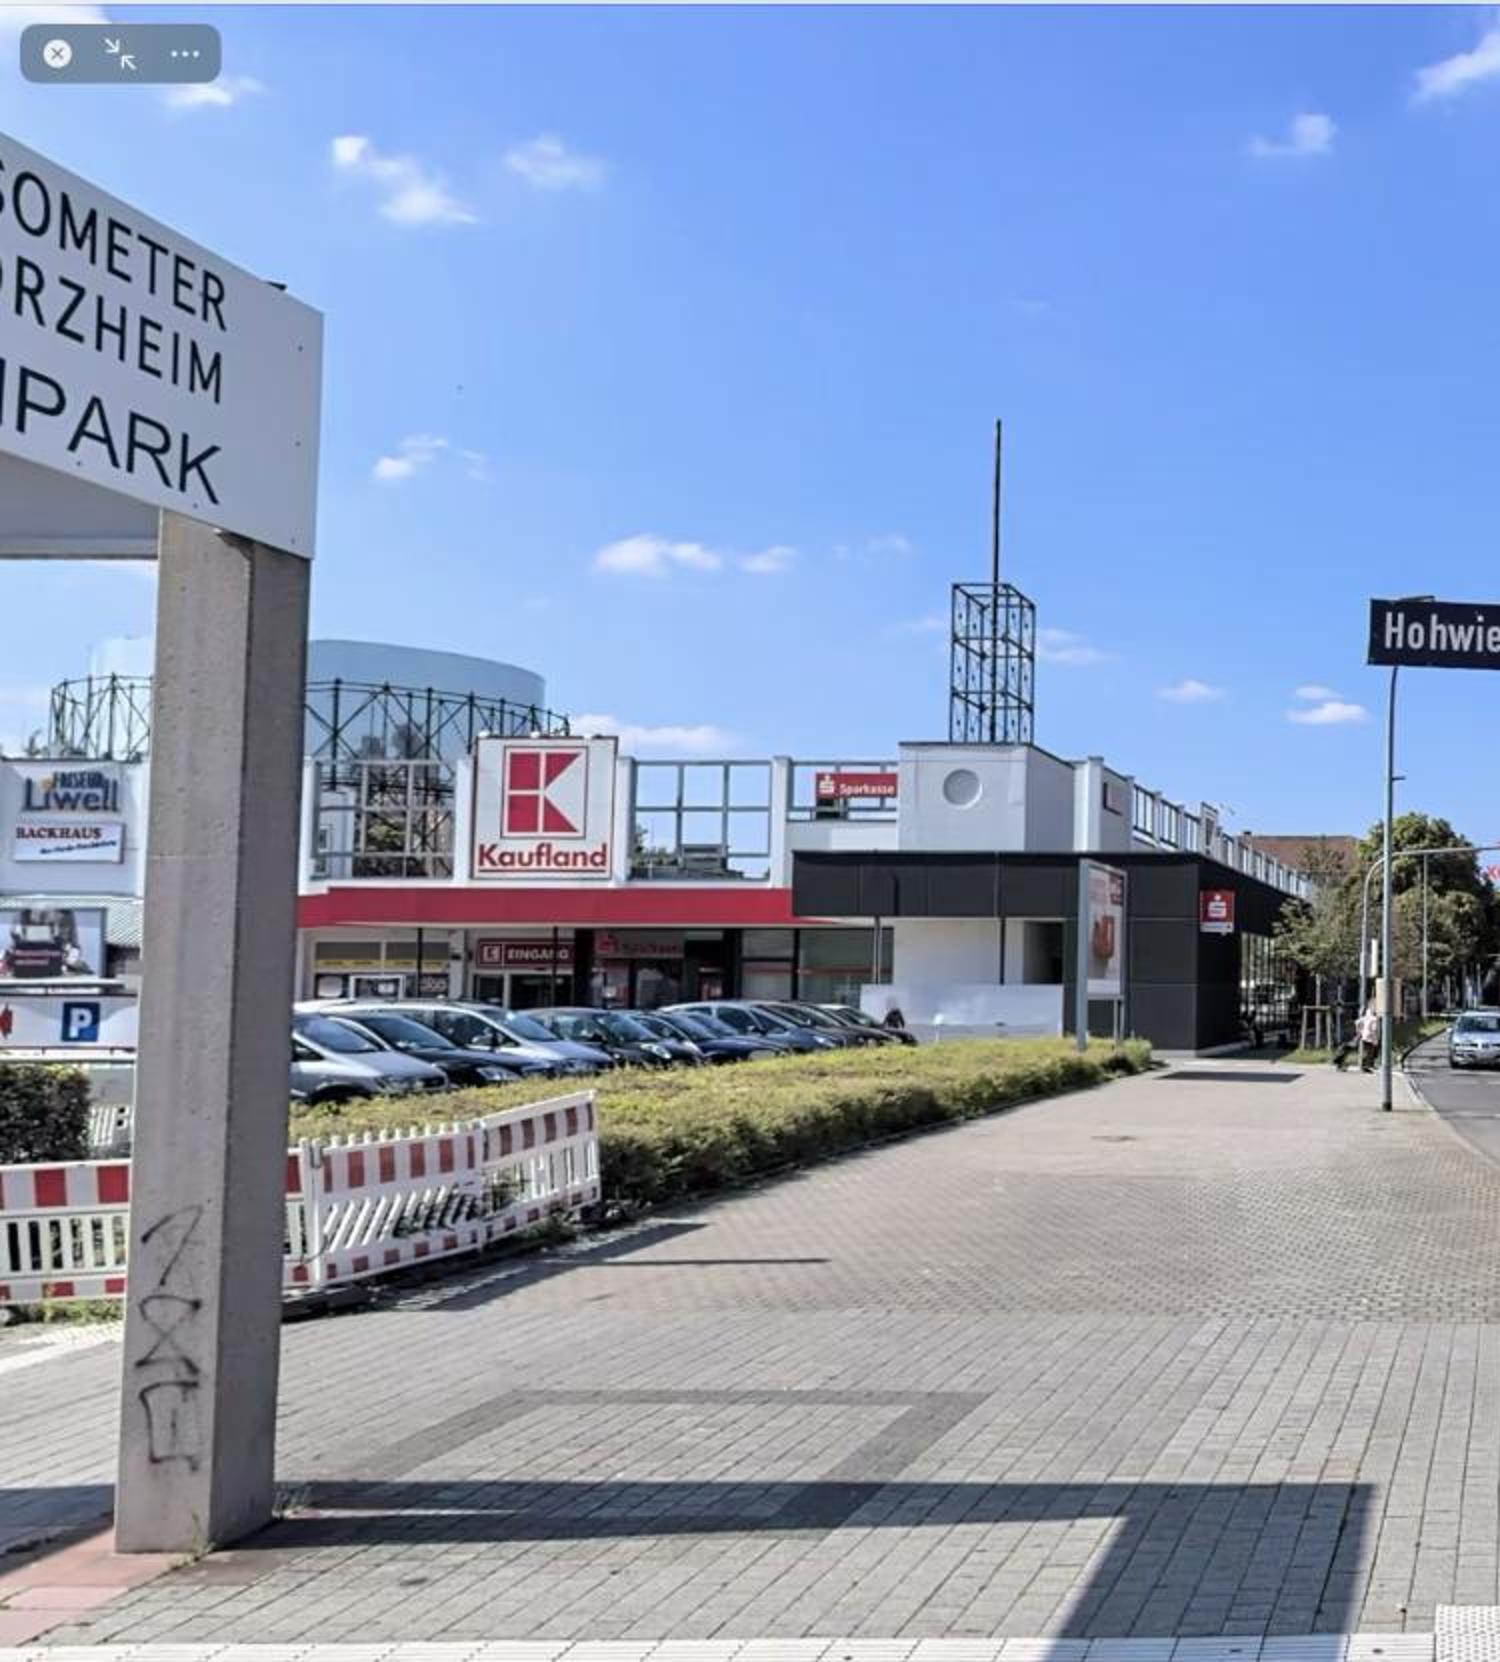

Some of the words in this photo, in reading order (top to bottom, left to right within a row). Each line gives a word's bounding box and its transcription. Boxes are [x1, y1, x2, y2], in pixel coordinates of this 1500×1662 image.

[0, 159, 227, 332] OMETER
[0, 255, 223, 405] RZHEIM
[0, 358, 222, 505] PARK
[839, 783, 895, 797] Sparkasse
[478, 842, 608, 867] Kaufland
[69, 1008, 93, 1038] P
